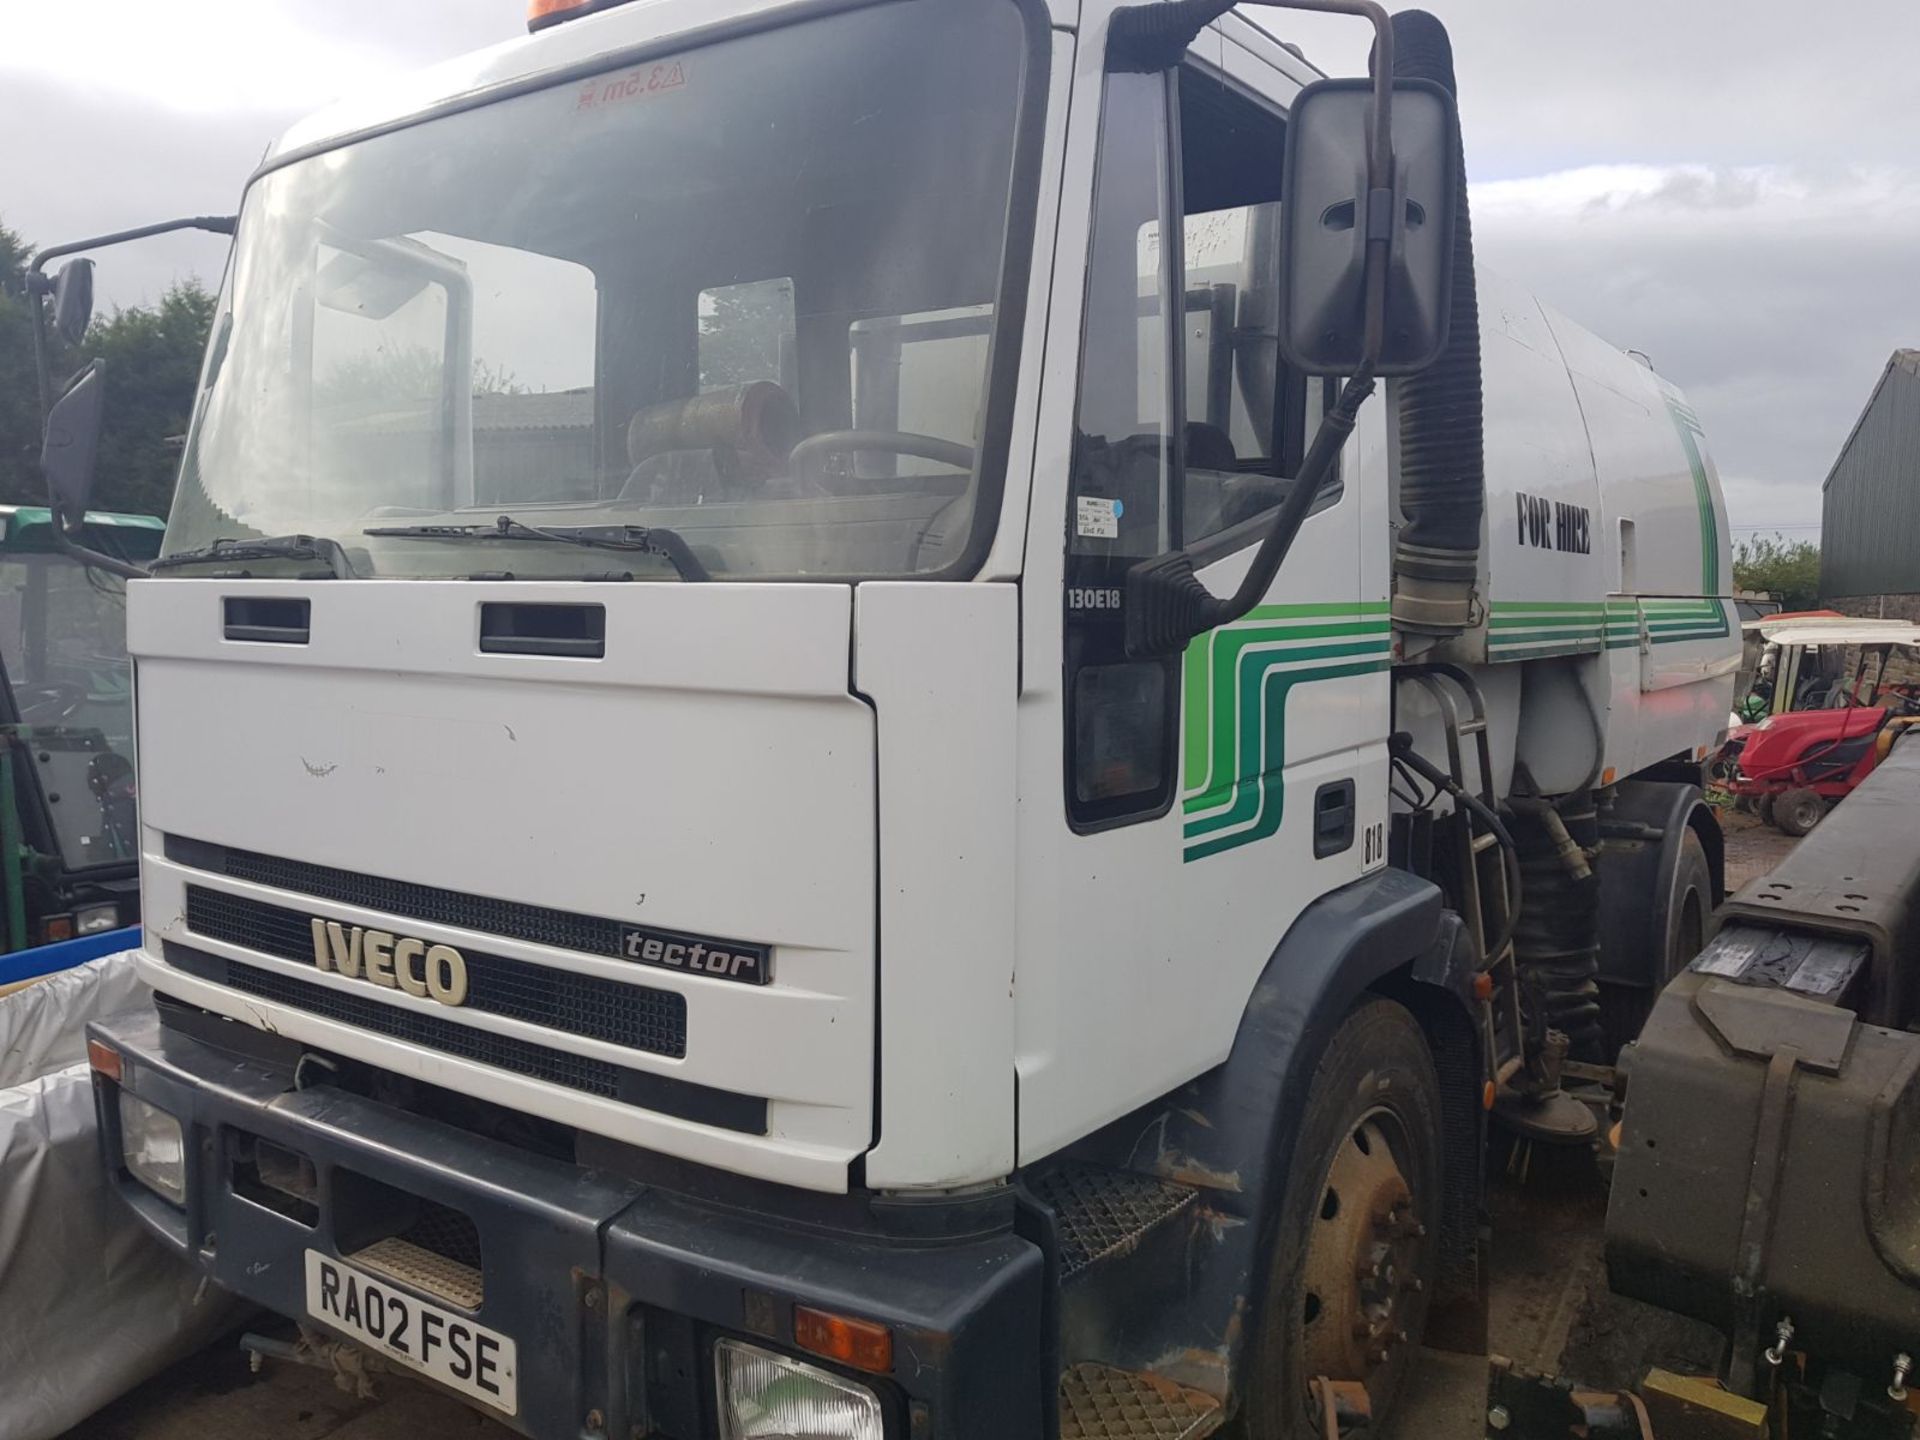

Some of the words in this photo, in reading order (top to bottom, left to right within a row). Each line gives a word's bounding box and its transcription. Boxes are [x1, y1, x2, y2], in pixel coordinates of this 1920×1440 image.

[1516, 491, 1552, 550] FOR
[1555, 501, 1591, 555] HIRE
[1068, 588, 1121, 609] 130E18
[1365, 822, 1383, 865] 818
[311, 918, 468, 1007] IVECO
[625, 930, 756, 976] tector
